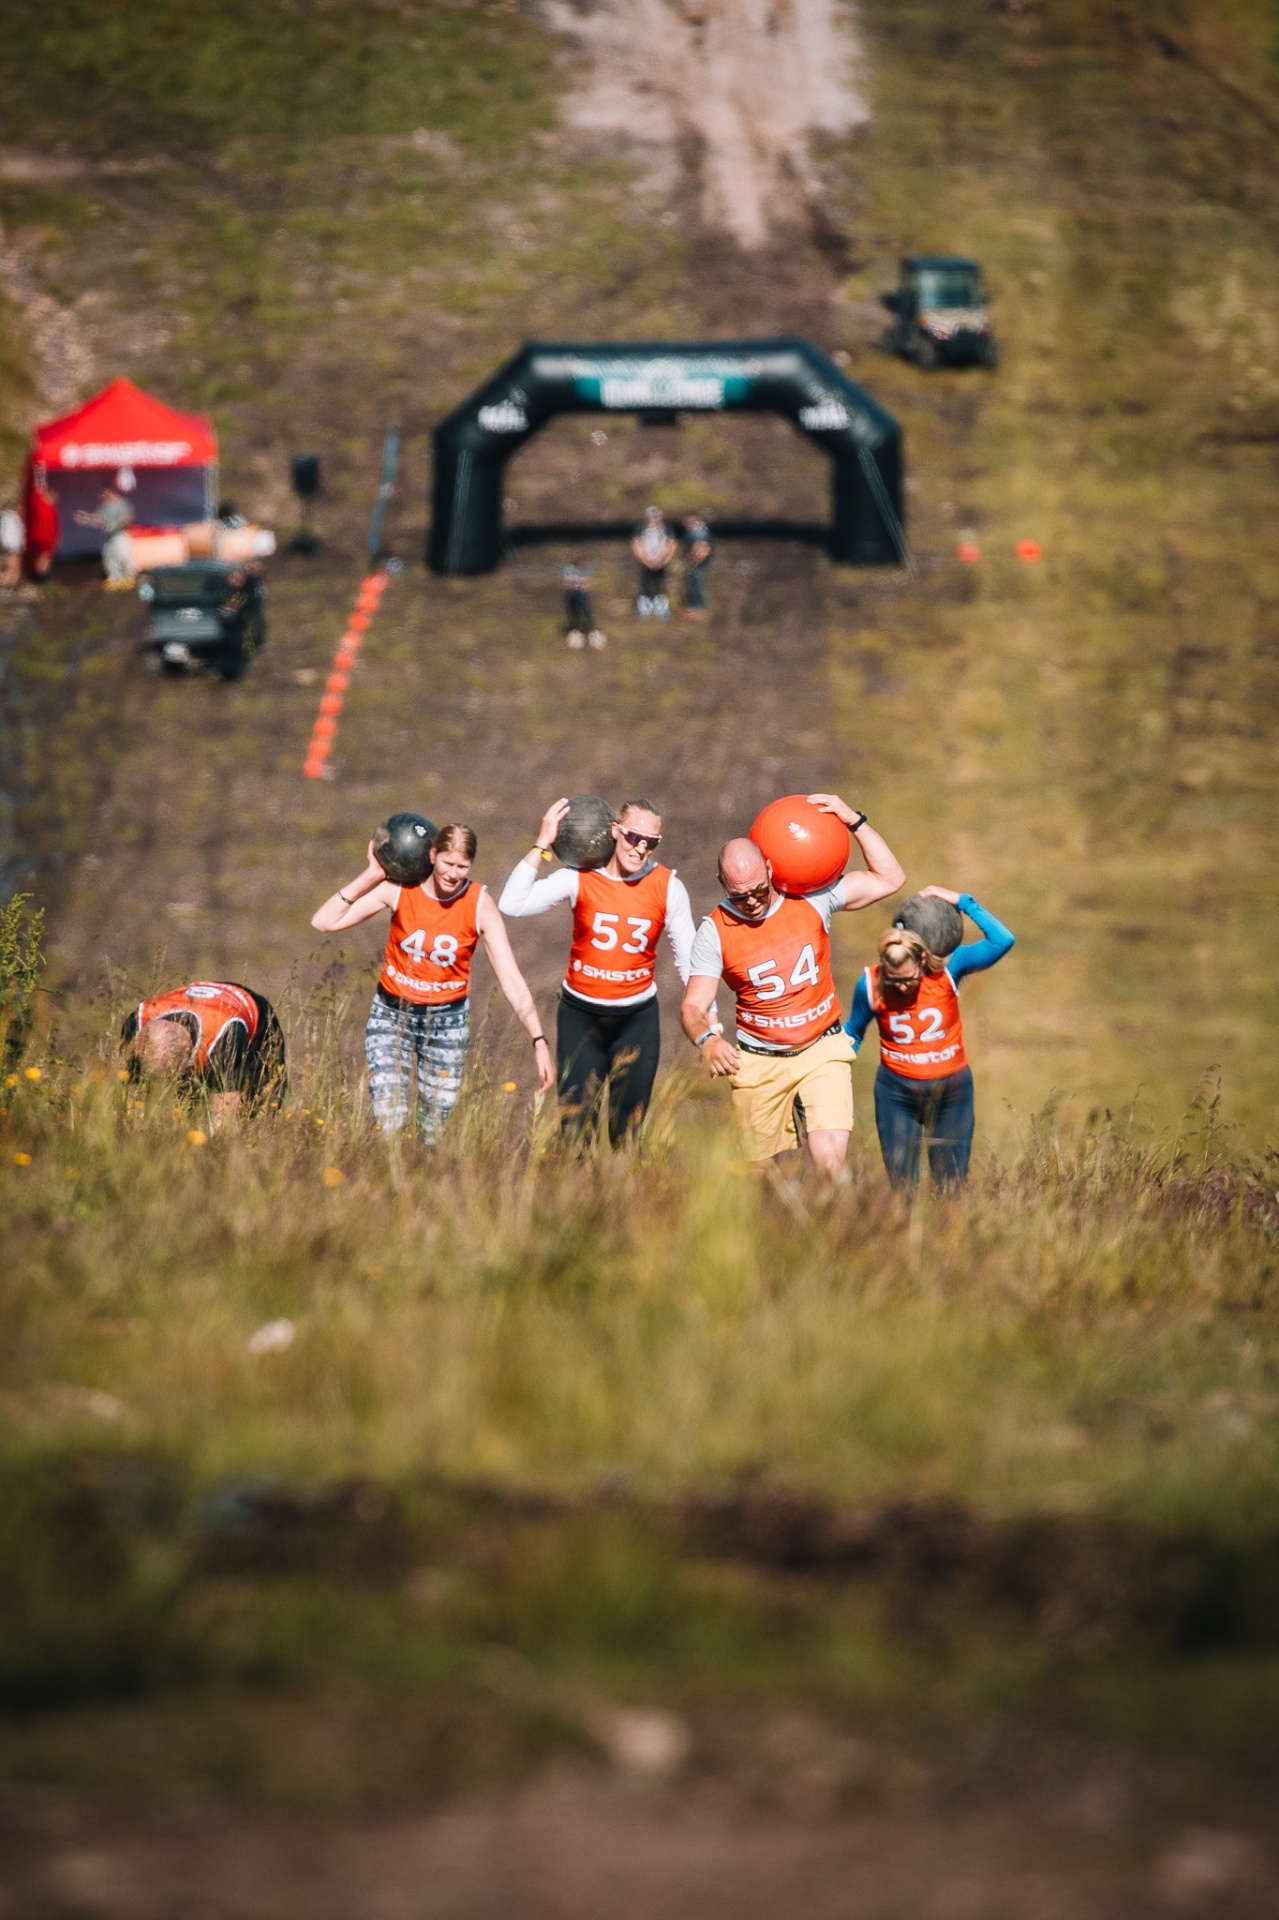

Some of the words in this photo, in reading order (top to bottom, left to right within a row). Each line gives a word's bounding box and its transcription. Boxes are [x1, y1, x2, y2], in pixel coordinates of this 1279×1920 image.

[400, 928, 459, 968] 48
[590, 911, 653, 954] 53
[747, 943, 819, 1000] 54
[889, 1007, 946, 1044] 52
